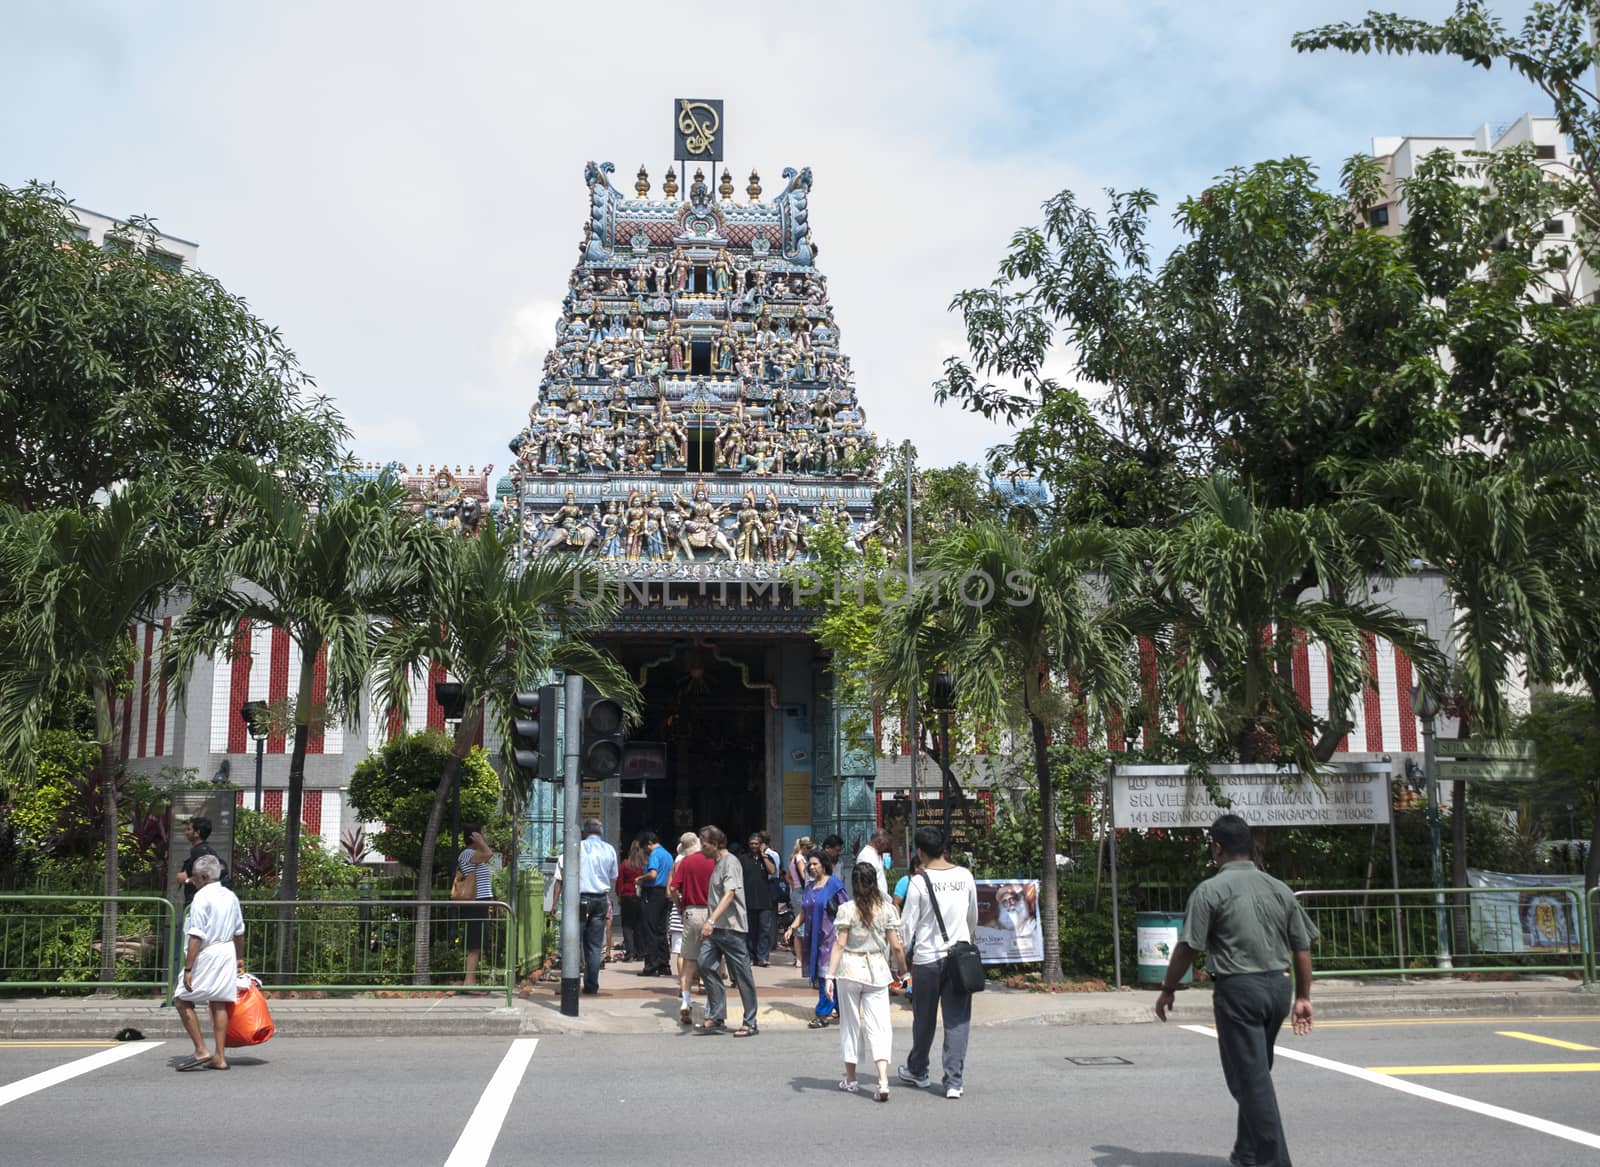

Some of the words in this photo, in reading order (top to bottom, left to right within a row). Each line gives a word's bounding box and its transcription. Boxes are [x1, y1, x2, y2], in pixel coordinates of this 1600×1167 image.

[1129, 792, 1153, 808] SRI
[1156, 791, 1313, 807] VEERAMKALIAMMAN
[1316, 791, 1373, 805] TEMPLE
[1130, 811, 1148, 823] 141
[1267, 807, 1333, 821] SINGAPORE
[1336, 807, 1374, 820] 218042
